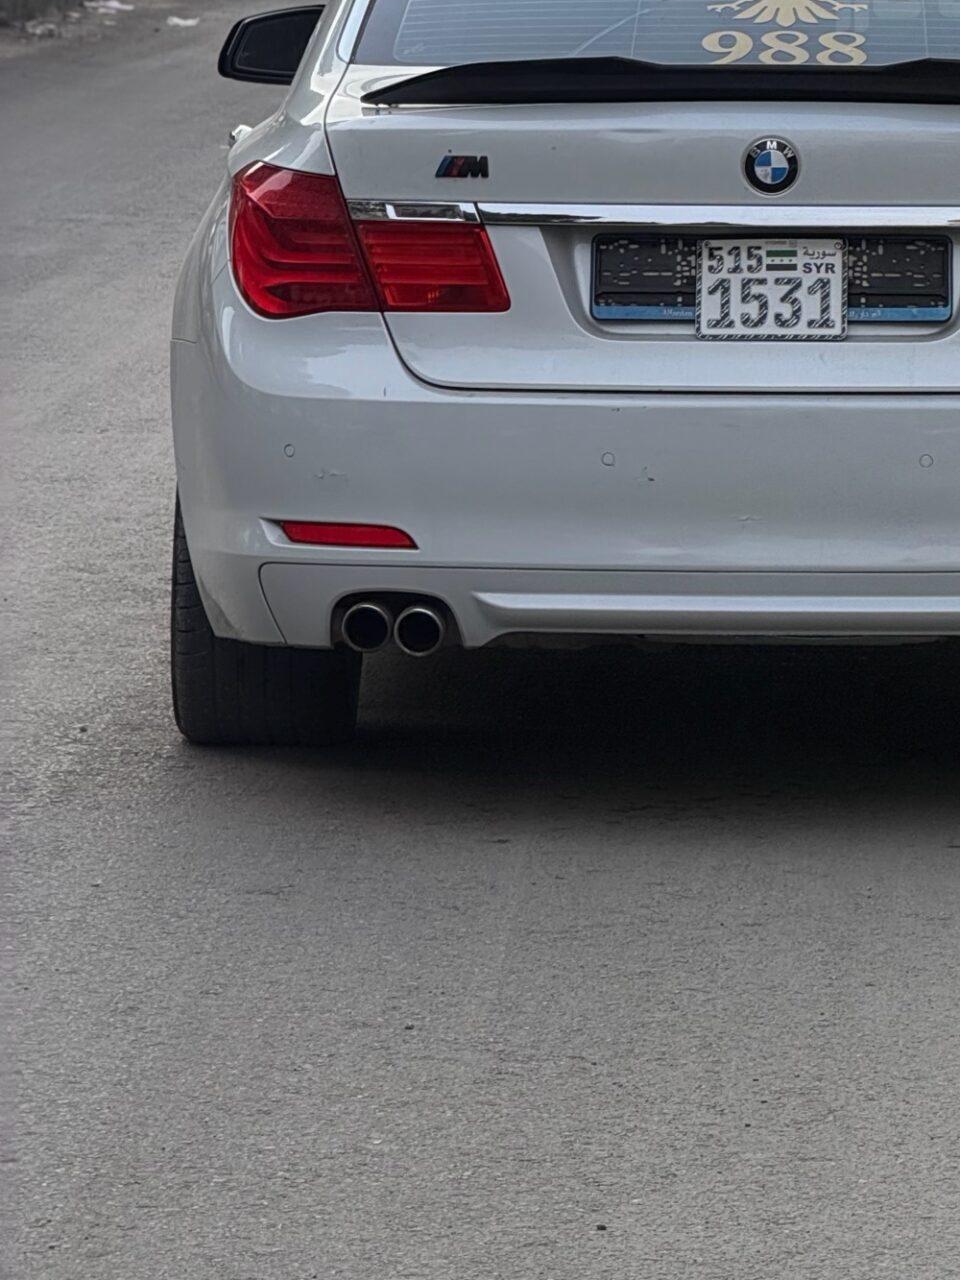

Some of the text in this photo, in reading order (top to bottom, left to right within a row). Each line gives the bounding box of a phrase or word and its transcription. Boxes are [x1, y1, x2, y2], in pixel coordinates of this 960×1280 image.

[702, 31, 867, 65] 988
[707, 246, 763, 274] 515
[802, 246, 837, 260] سورية
[802, 262, 836, 274] SYR
[706, 277, 836, 329] 1531
